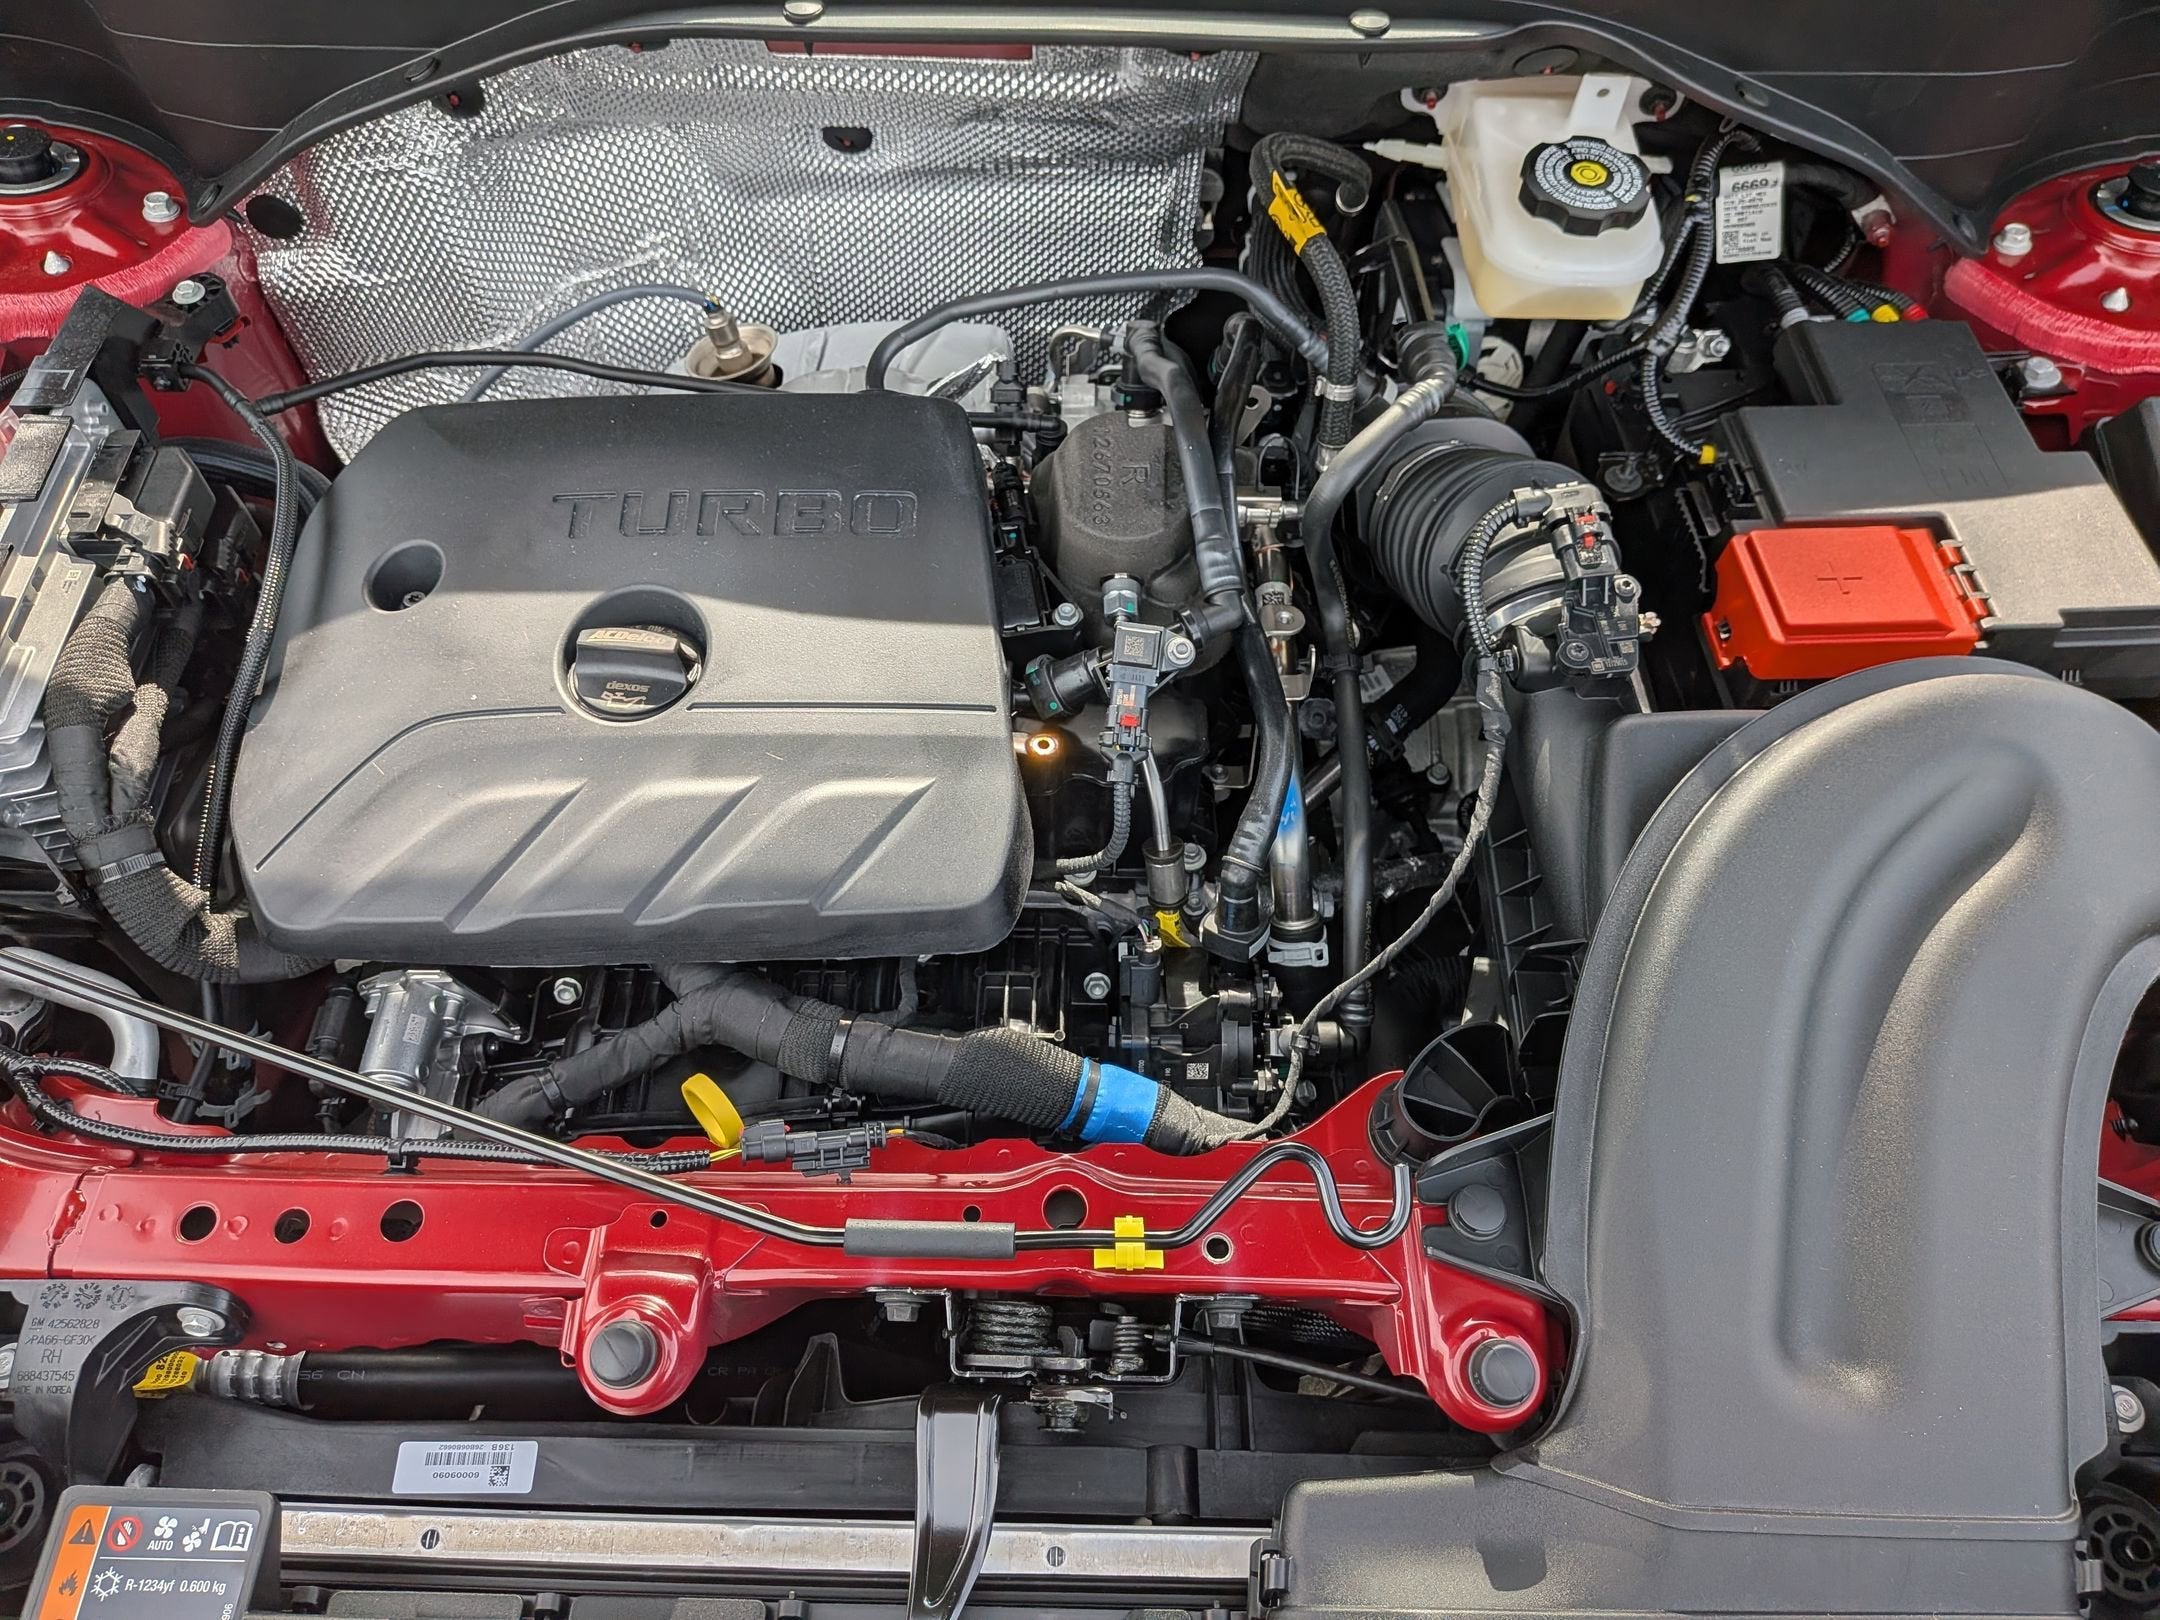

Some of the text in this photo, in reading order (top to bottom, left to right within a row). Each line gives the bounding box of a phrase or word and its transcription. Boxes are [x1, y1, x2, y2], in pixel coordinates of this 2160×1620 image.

[1731, 179, 1769, 193] 6669
[1121, 463, 1151, 485] R
[552, 488, 918, 538] TURBO
[587, 630, 665, 644] ACDelco
[606, 681, 651, 693] dexos
[31, 1316, 100, 1330] GM 42562828
[40, 1348, 63, 1364] RH
[17, 1370, 76, 1382] 688437545
[336, 1369, 366, 1381] CN
[35, 1385, 43, 1394] IN
[46, 1385, 72, 1394] KOREA
[432, 1471, 480, 1479] 60009090
[147, 1540, 174, 1551] AUTO
[124, 1578, 227, 1595] R-1234yf 0.600 kg
